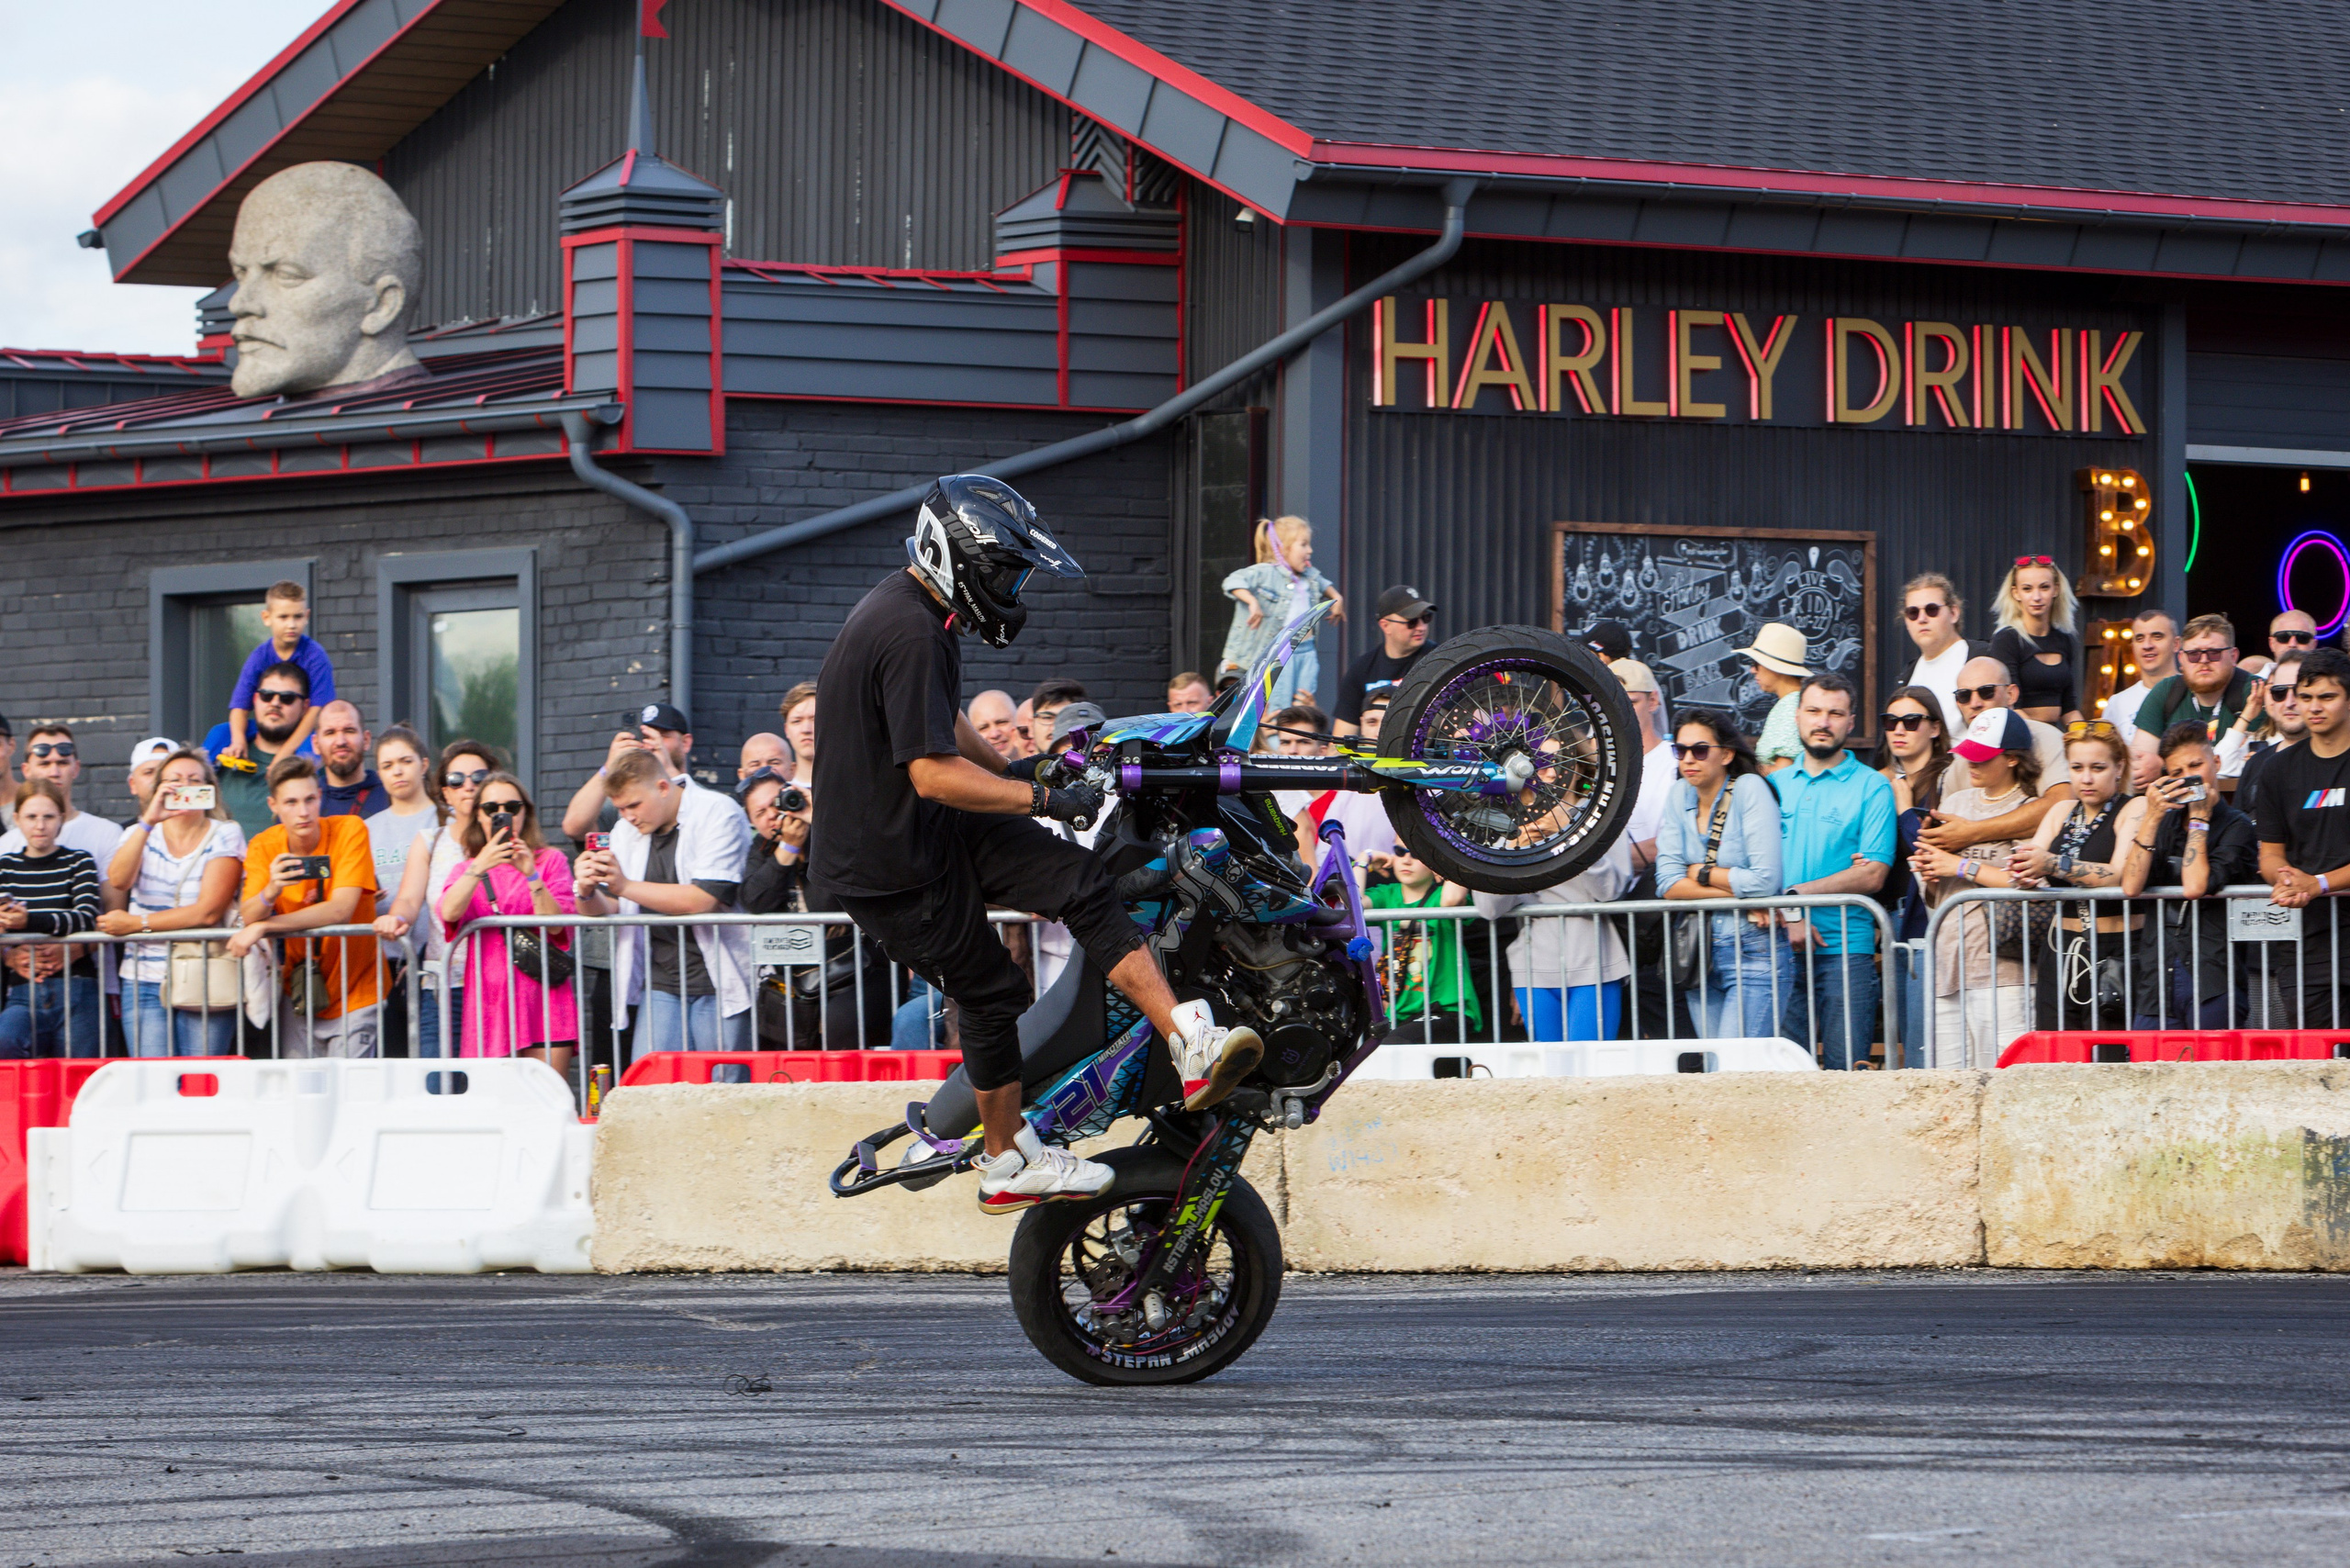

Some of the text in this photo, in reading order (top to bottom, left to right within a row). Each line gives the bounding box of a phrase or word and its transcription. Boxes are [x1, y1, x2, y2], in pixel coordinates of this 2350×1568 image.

[1373, 297, 2147, 434] HARLEY DRINK
[1028, 529, 1058, 550] CODERED
[1796, 573, 1829, 588] LIVE
[1778, 594, 1845, 621] FRIDAY
[1676, 617, 1725, 650] DRINK
[1684, 662, 1723, 691] BAR
[1263, 798, 1288, 836] Husqvarna
[1705, 810, 1728, 865] STELA
[1051, 1061, 1110, 1132] 21
